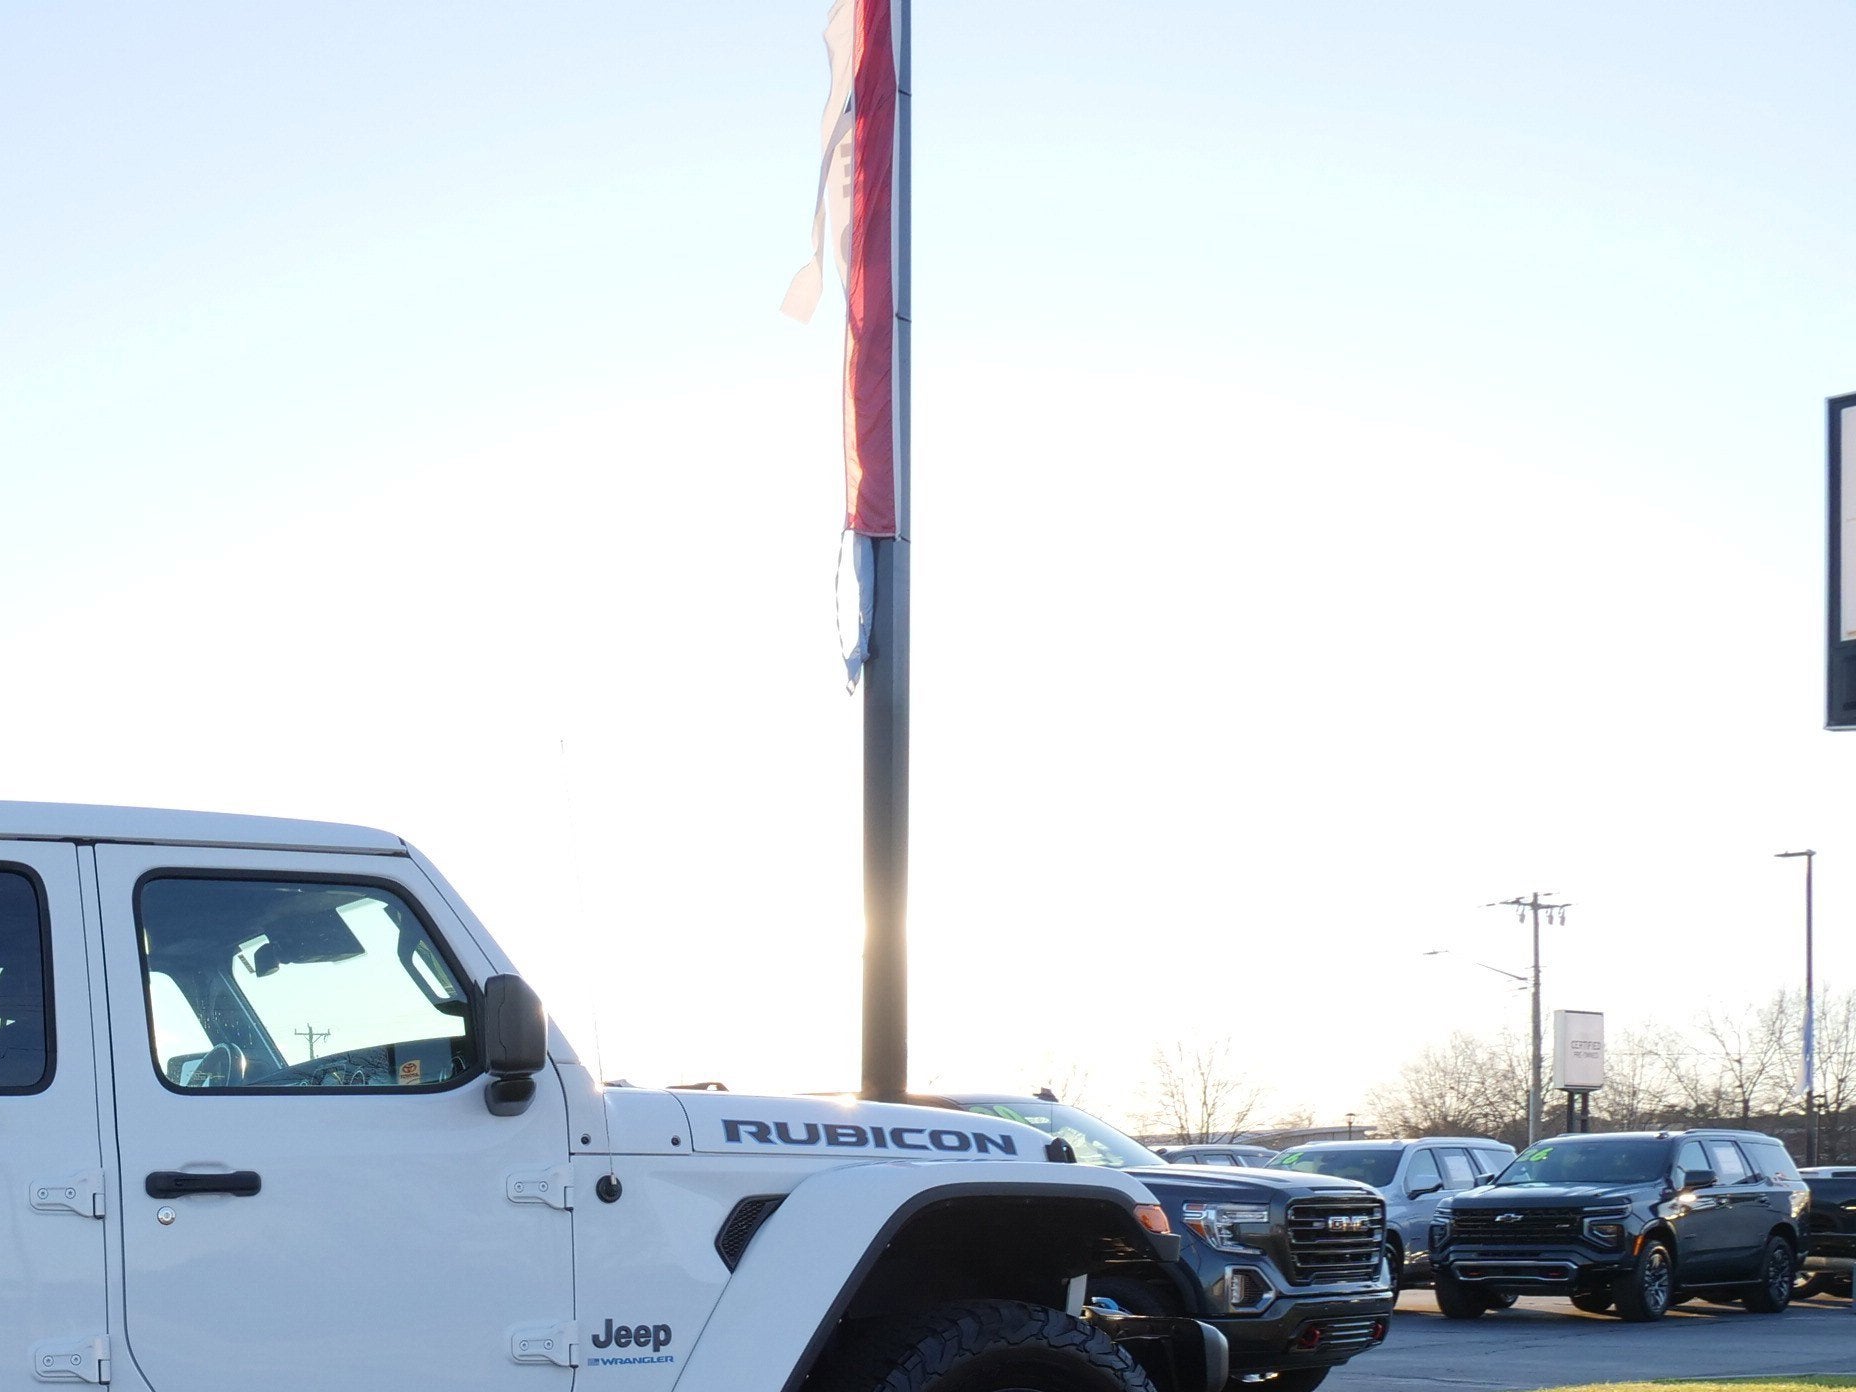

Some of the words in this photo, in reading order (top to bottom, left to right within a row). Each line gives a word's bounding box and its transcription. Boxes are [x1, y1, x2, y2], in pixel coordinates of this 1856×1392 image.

[721, 1118, 1018, 1156] RUBICON
[591, 1318, 672, 1352] Jeep
[600, 1355, 674, 1366] WRANGLER
